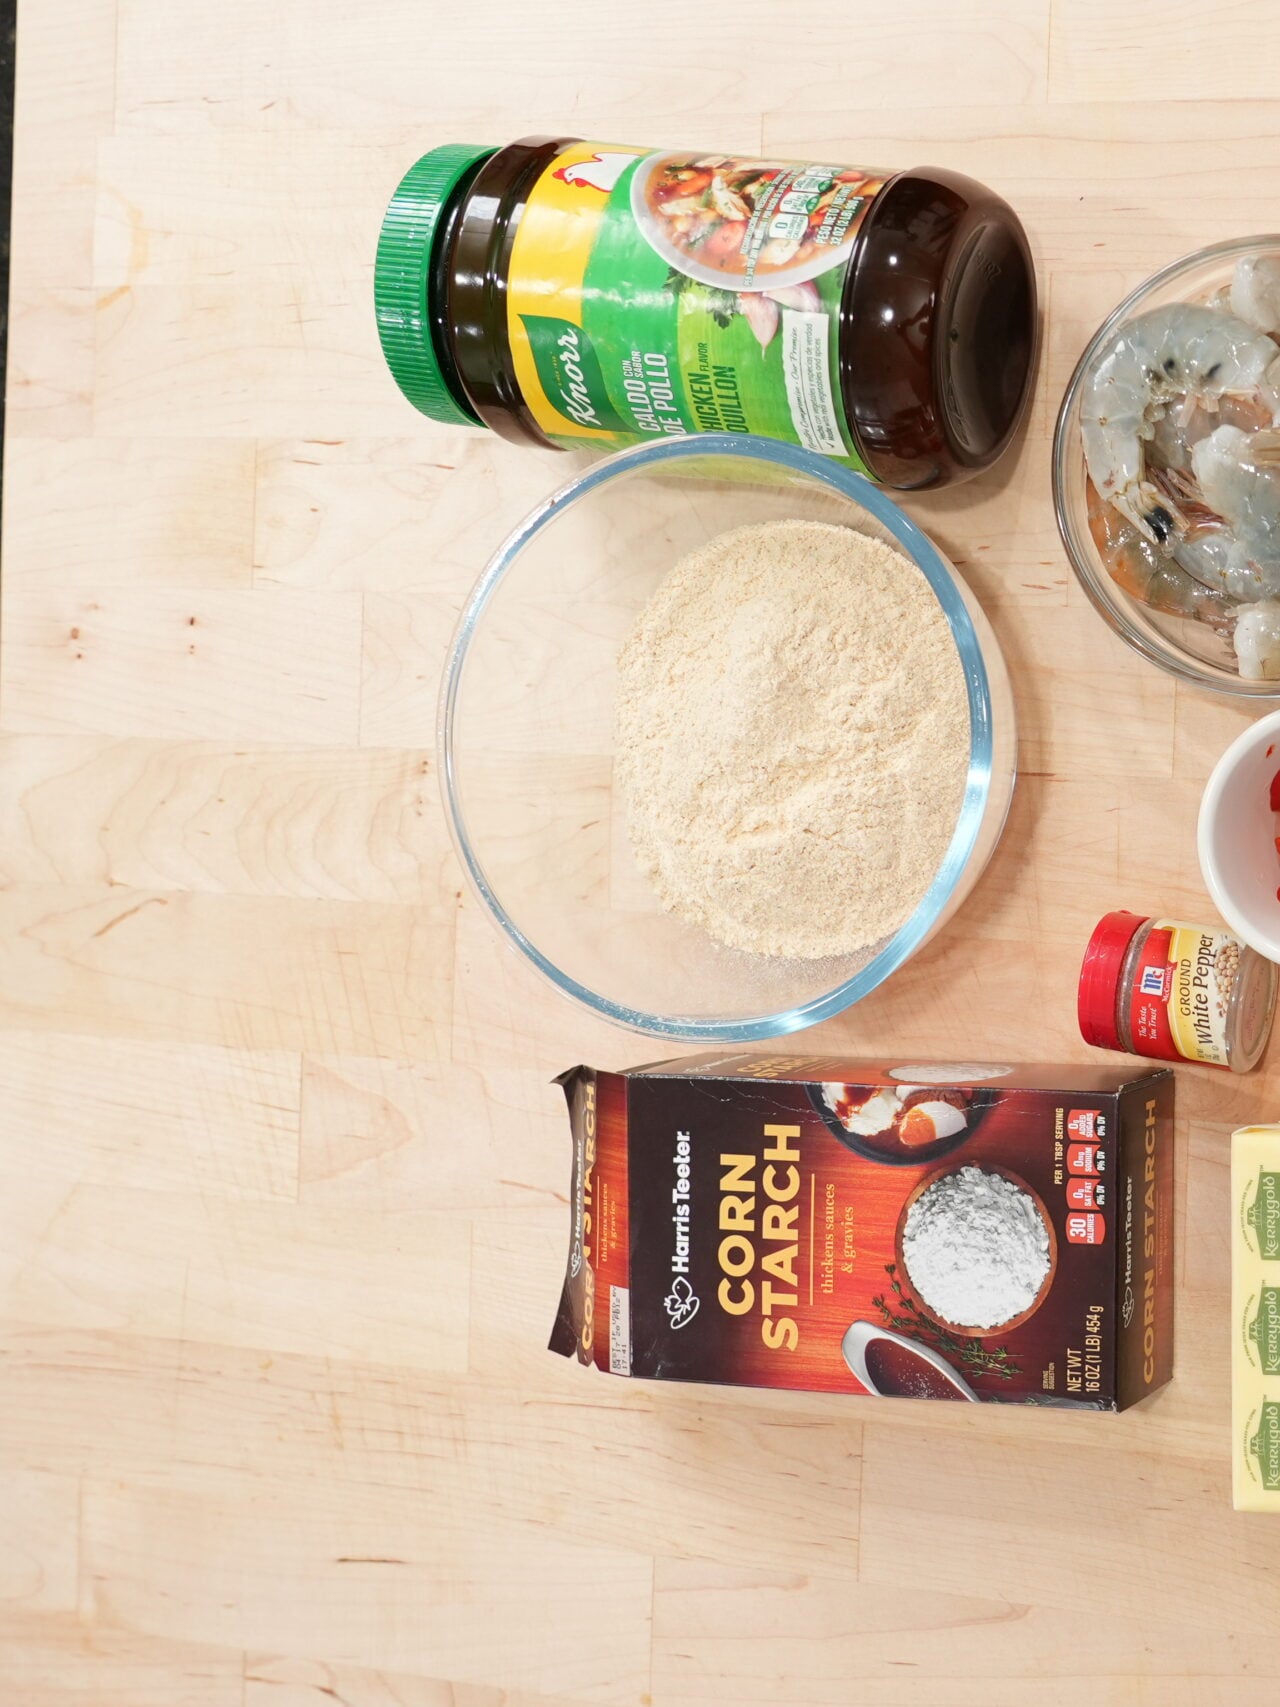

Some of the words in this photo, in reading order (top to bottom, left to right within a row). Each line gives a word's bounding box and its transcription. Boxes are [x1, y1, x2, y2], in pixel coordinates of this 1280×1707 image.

[822, 208, 838, 226] NETO
[840, 209, 855, 220] LB)
[815, 226, 831, 244] PESO
[830, 236, 843, 245] 32
[834, 226, 847, 236] OZ
[805, 323, 813, 346] verdad
[698, 342, 709, 372] FLAVOR
[805, 347, 812, 356] de
[813, 338, 821, 357] spices
[622, 360, 633, 377] CON
[631, 351, 644, 378] SABOR
[806, 357, 815, 382] especias
[814, 358, 822, 371] and
[558, 328, 602, 425] Knorr
[643, 353, 678, 411] POLLO
[815, 371, 828, 403] vegetables
[623, 379, 661, 431] CALDO
[688, 372, 724, 433] HICKEN
[712, 366, 750, 433] OUILLON
[809, 387, 820, 414] vegetales
[820, 403, 828, 415] real
[658, 416, 687, 434] DE
[822, 415, 831, 427] with
[1192, 934, 1215, 989] Pepper
[1161, 966, 1172, 1002] McCormick
[1180, 959, 1191, 1017] GROUND
[1138, 1006, 1147, 1025] Taste
[1192, 993, 1214, 1044] White
[1138, 1027, 1147, 1037] The
[1149, 1028, 1157, 1040] You
[1055, 1108, 1064, 1140] SERVING
[1079, 1114, 1087, 1135] ADDED
[1086, 1113, 1094, 1138] SUGARS
[1097, 1116, 1105, 1124] DV
[1097, 1126, 1106, 1136] 0%
[1054, 1142, 1063, 1160] TBSP
[1085, 1147, 1093, 1172] SODIUM
[1097, 1151, 1105, 1159] DV
[1097, 1160, 1105, 1171] 0%
[1054, 1170, 1063, 1185] PER
[1084, 1181, 1092, 1193] FAT
[1143, 1098, 1156, 1257] STARCH
[1097, 1184, 1105, 1194] DV
[824, 1184, 835, 1231] sauces
[1084, 1194, 1092, 1207] SAT
[1097, 1194, 1105, 1205] 0%
[1263, 1176, 1280, 1257] Kerrygold
[717, 1153, 756, 1316] CORN
[841, 1206, 856, 1258] gravies
[1069, 1218, 1086, 1237] 30
[1087, 1213, 1095, 1243] CALORIES
[672, 1204, 690, 1273] Harris
[761, 1124, 801, 1352] STARCH
[821, 1233, 835, 1293] thickens
[841, 1261, 853, 1273] &
[1086, 1314, 1100, 1333] 454
[1143, 1268, 1155, 1384] CORN
[1085, 1334, 1102, 1352] LB)
[1066, 1348, 1082, 1368] WT
[1085, 1355, 1102, 1363] (1
[1066, 1369, 1082, 1392] NET
[1085, 1364, 1100, 1380] OZ
[1085, 1382, 1100, 1392] 16
